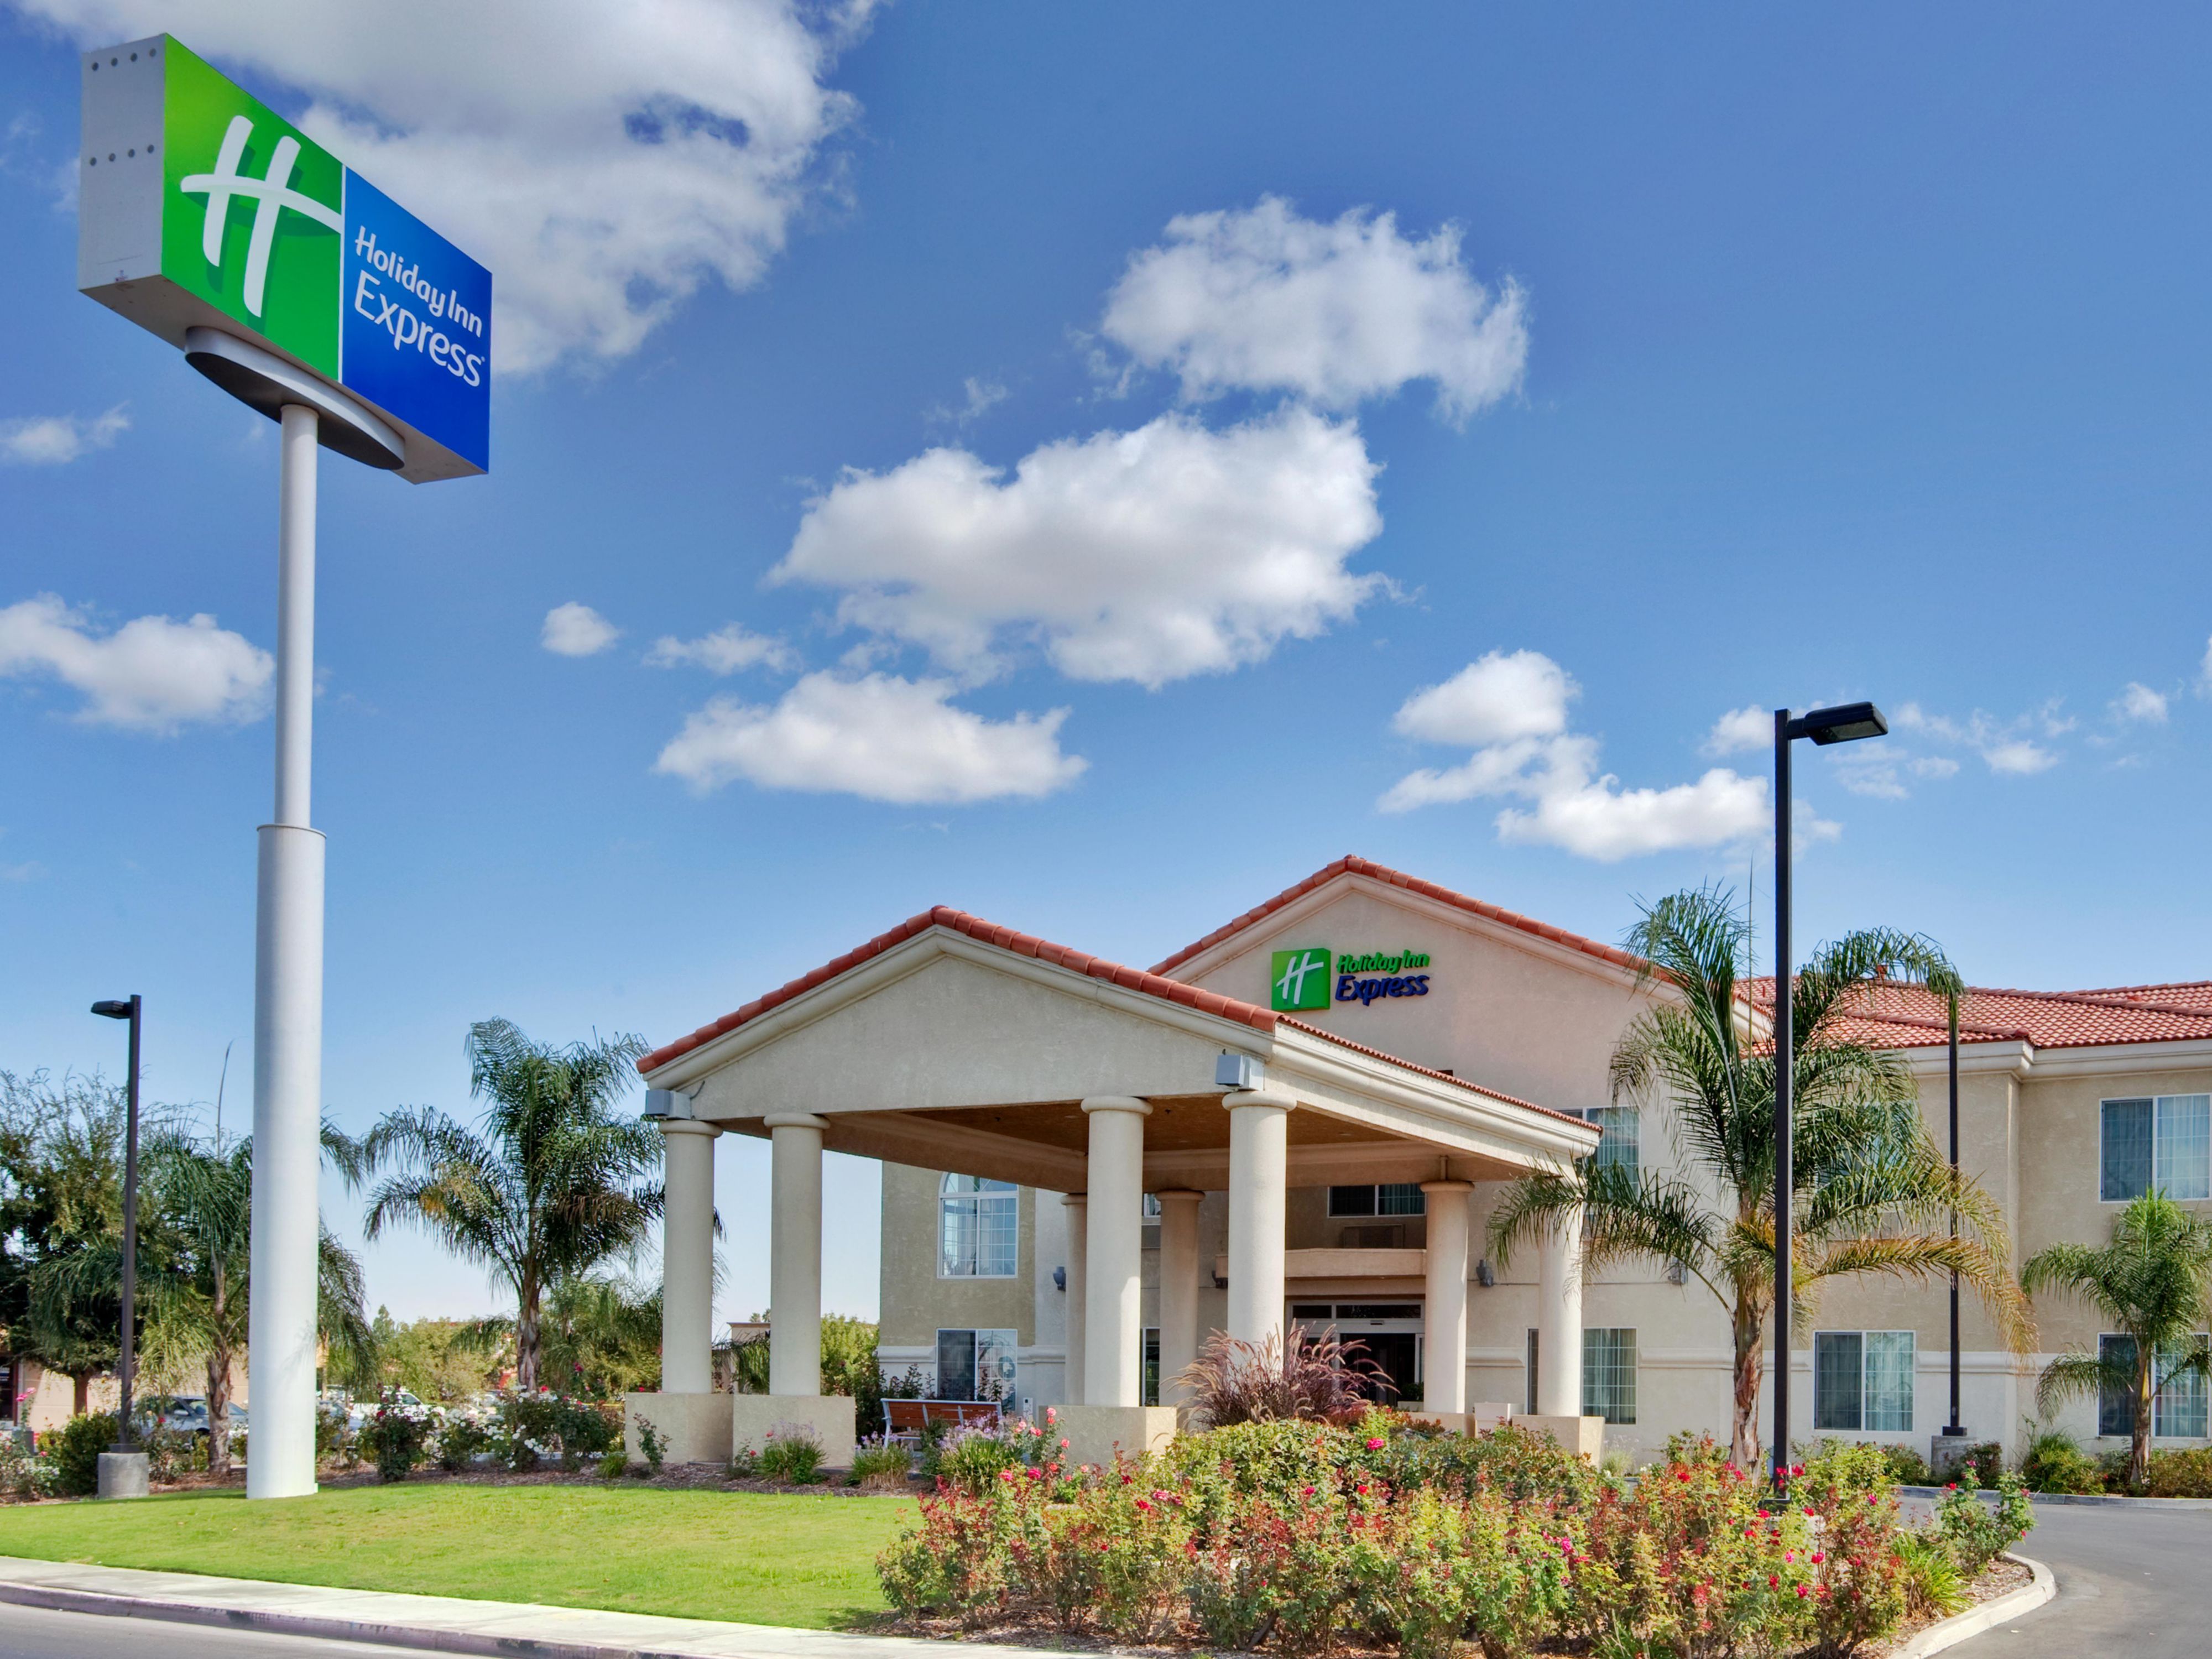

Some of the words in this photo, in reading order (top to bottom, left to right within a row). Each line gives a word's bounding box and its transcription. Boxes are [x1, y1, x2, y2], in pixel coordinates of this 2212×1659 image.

[354, 225, 446, 317] Holiday
[447, 289, 482, 338] Inn
[354, 269, 481, 387] Express
[1335, 975, 1430, 1006] Express
[1336, 952, 1401, 974] Holiday
[1402, 949, 1430, 968] Inn
